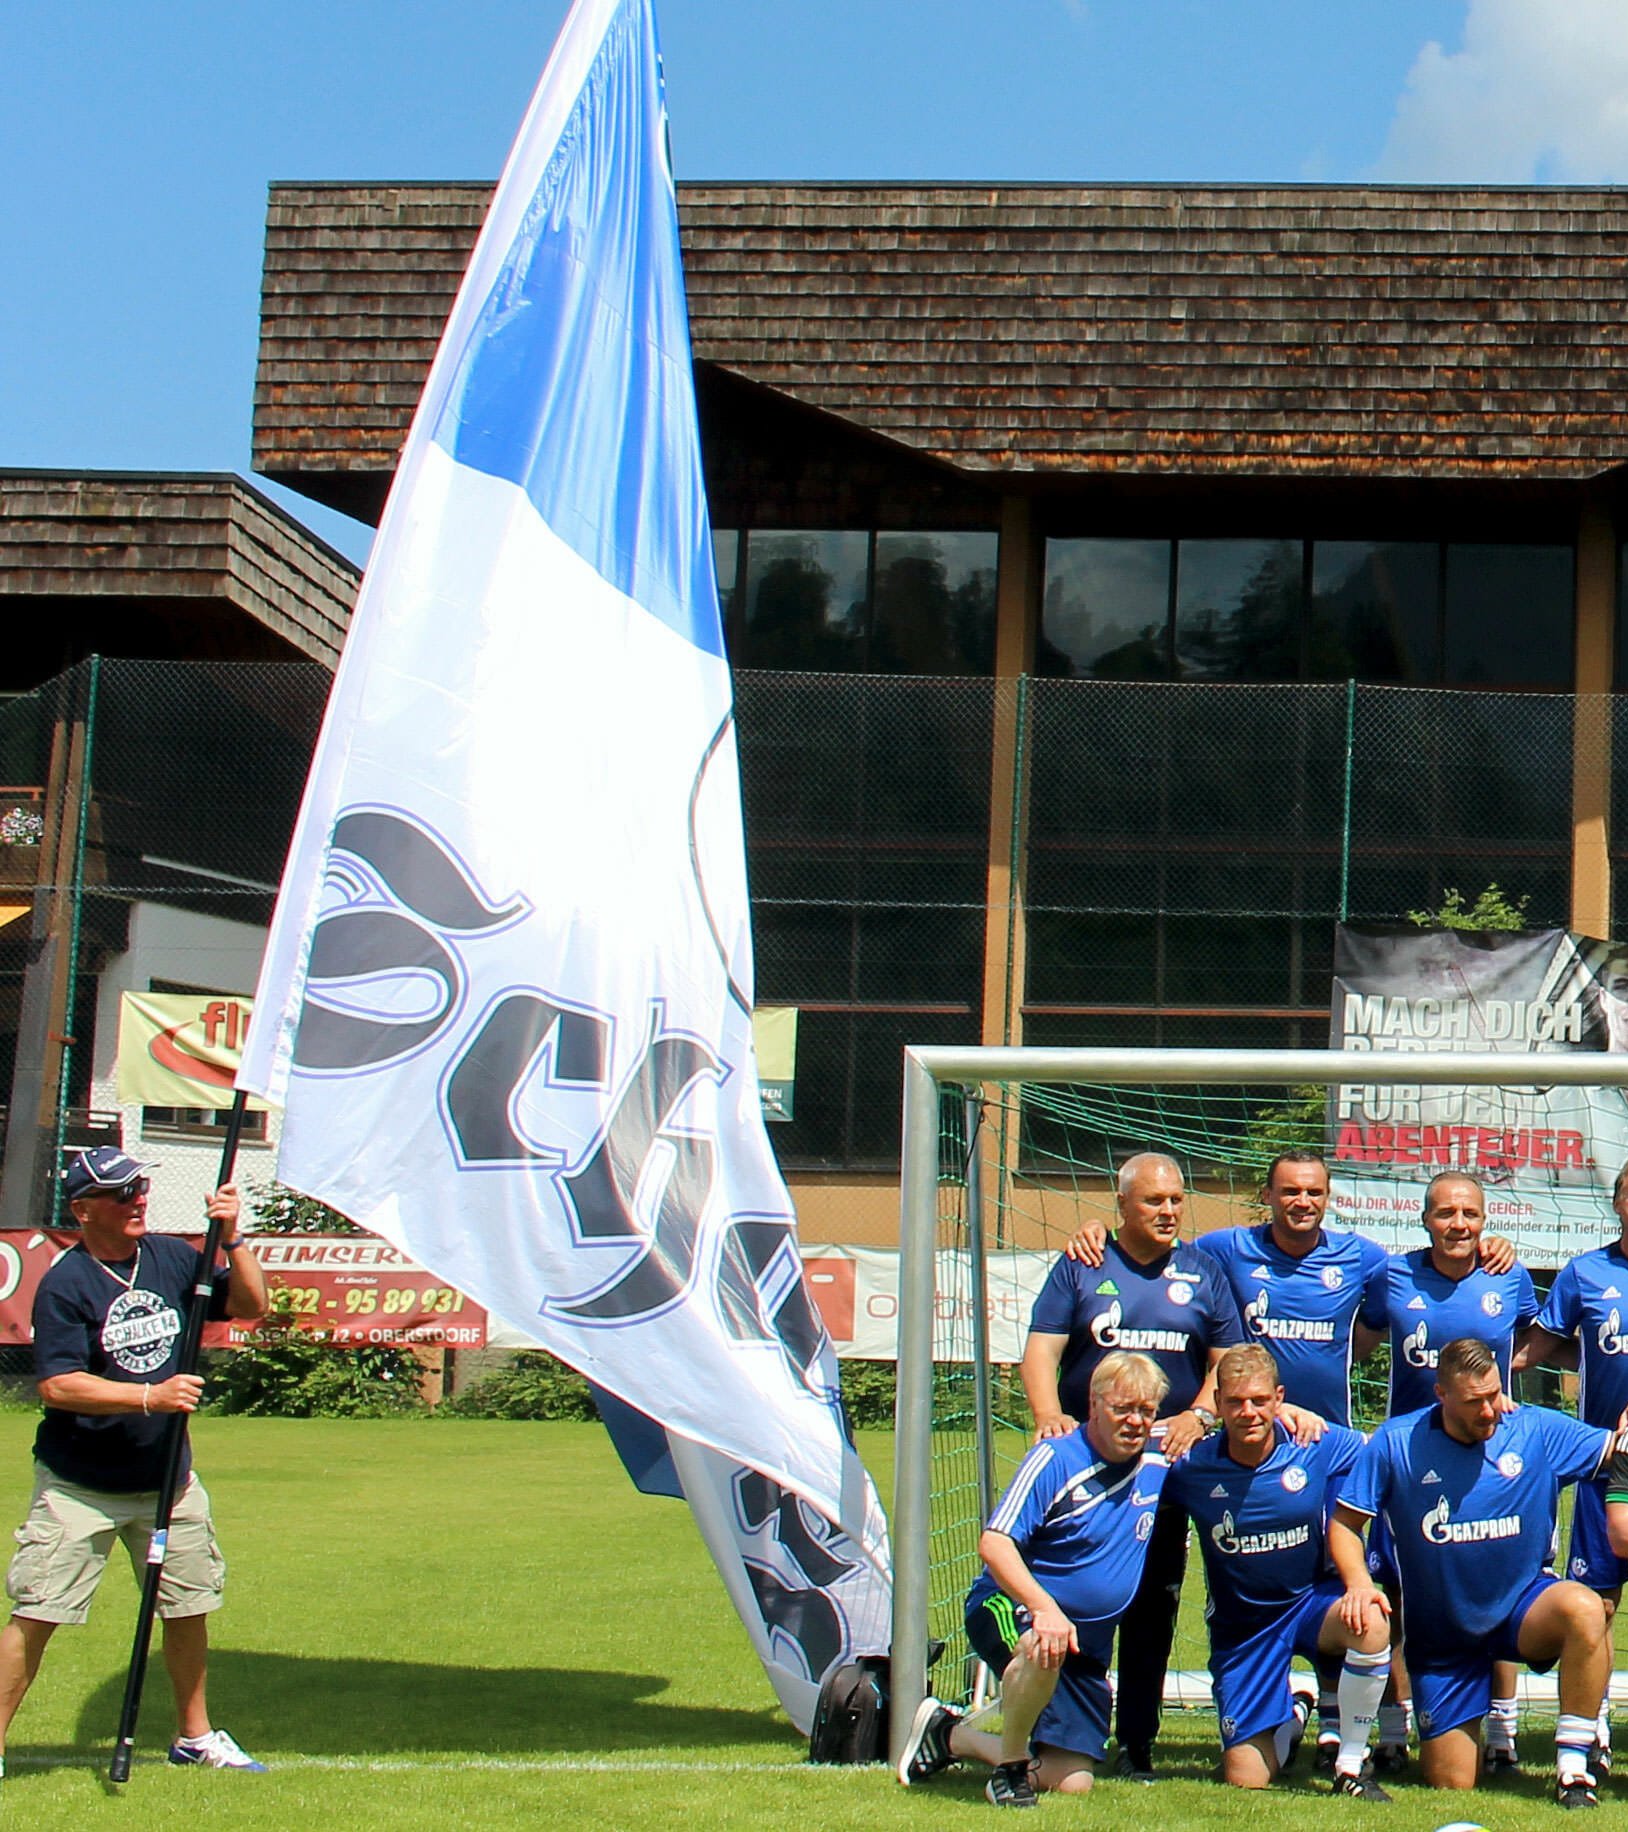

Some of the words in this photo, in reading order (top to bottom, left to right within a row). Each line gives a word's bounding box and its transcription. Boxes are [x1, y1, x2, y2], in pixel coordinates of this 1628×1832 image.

[1343, 993, 1470, 1039] MACH
[1484, 1000, 1584, 1044] DICH
[1334, 1120, 1598, 1170] ABENTEUER.
[1335, 1196, 1363, 1209] BAU
[1366, 1198, 1388, 1211] DIR
[1391, 1199, 1421, 1212] WAS
[1487, 1201, 1537, 1215] GEIGER.
[1335, 1215, 1375, 1227] Bewirb
[1545, 1223, 1571, 1234] zum
[1573, 1221, 1600, 1235] Tief-
[344, 1288, 379, 1315] 95
[382, 1288, 416, 1315] 89
[420, 1288, 465, 1314] 931
[368, 1328, 482, 1344] OBERSTDORF
[1119, 1329, 1190, 1352] GAZPROM
[1268, 1317, 1335, 1342] GAZPROM
[1239, 1523, 1310, 1555] GAZPROM
[1451, 1514, 1522, 1543] GAZPROM
